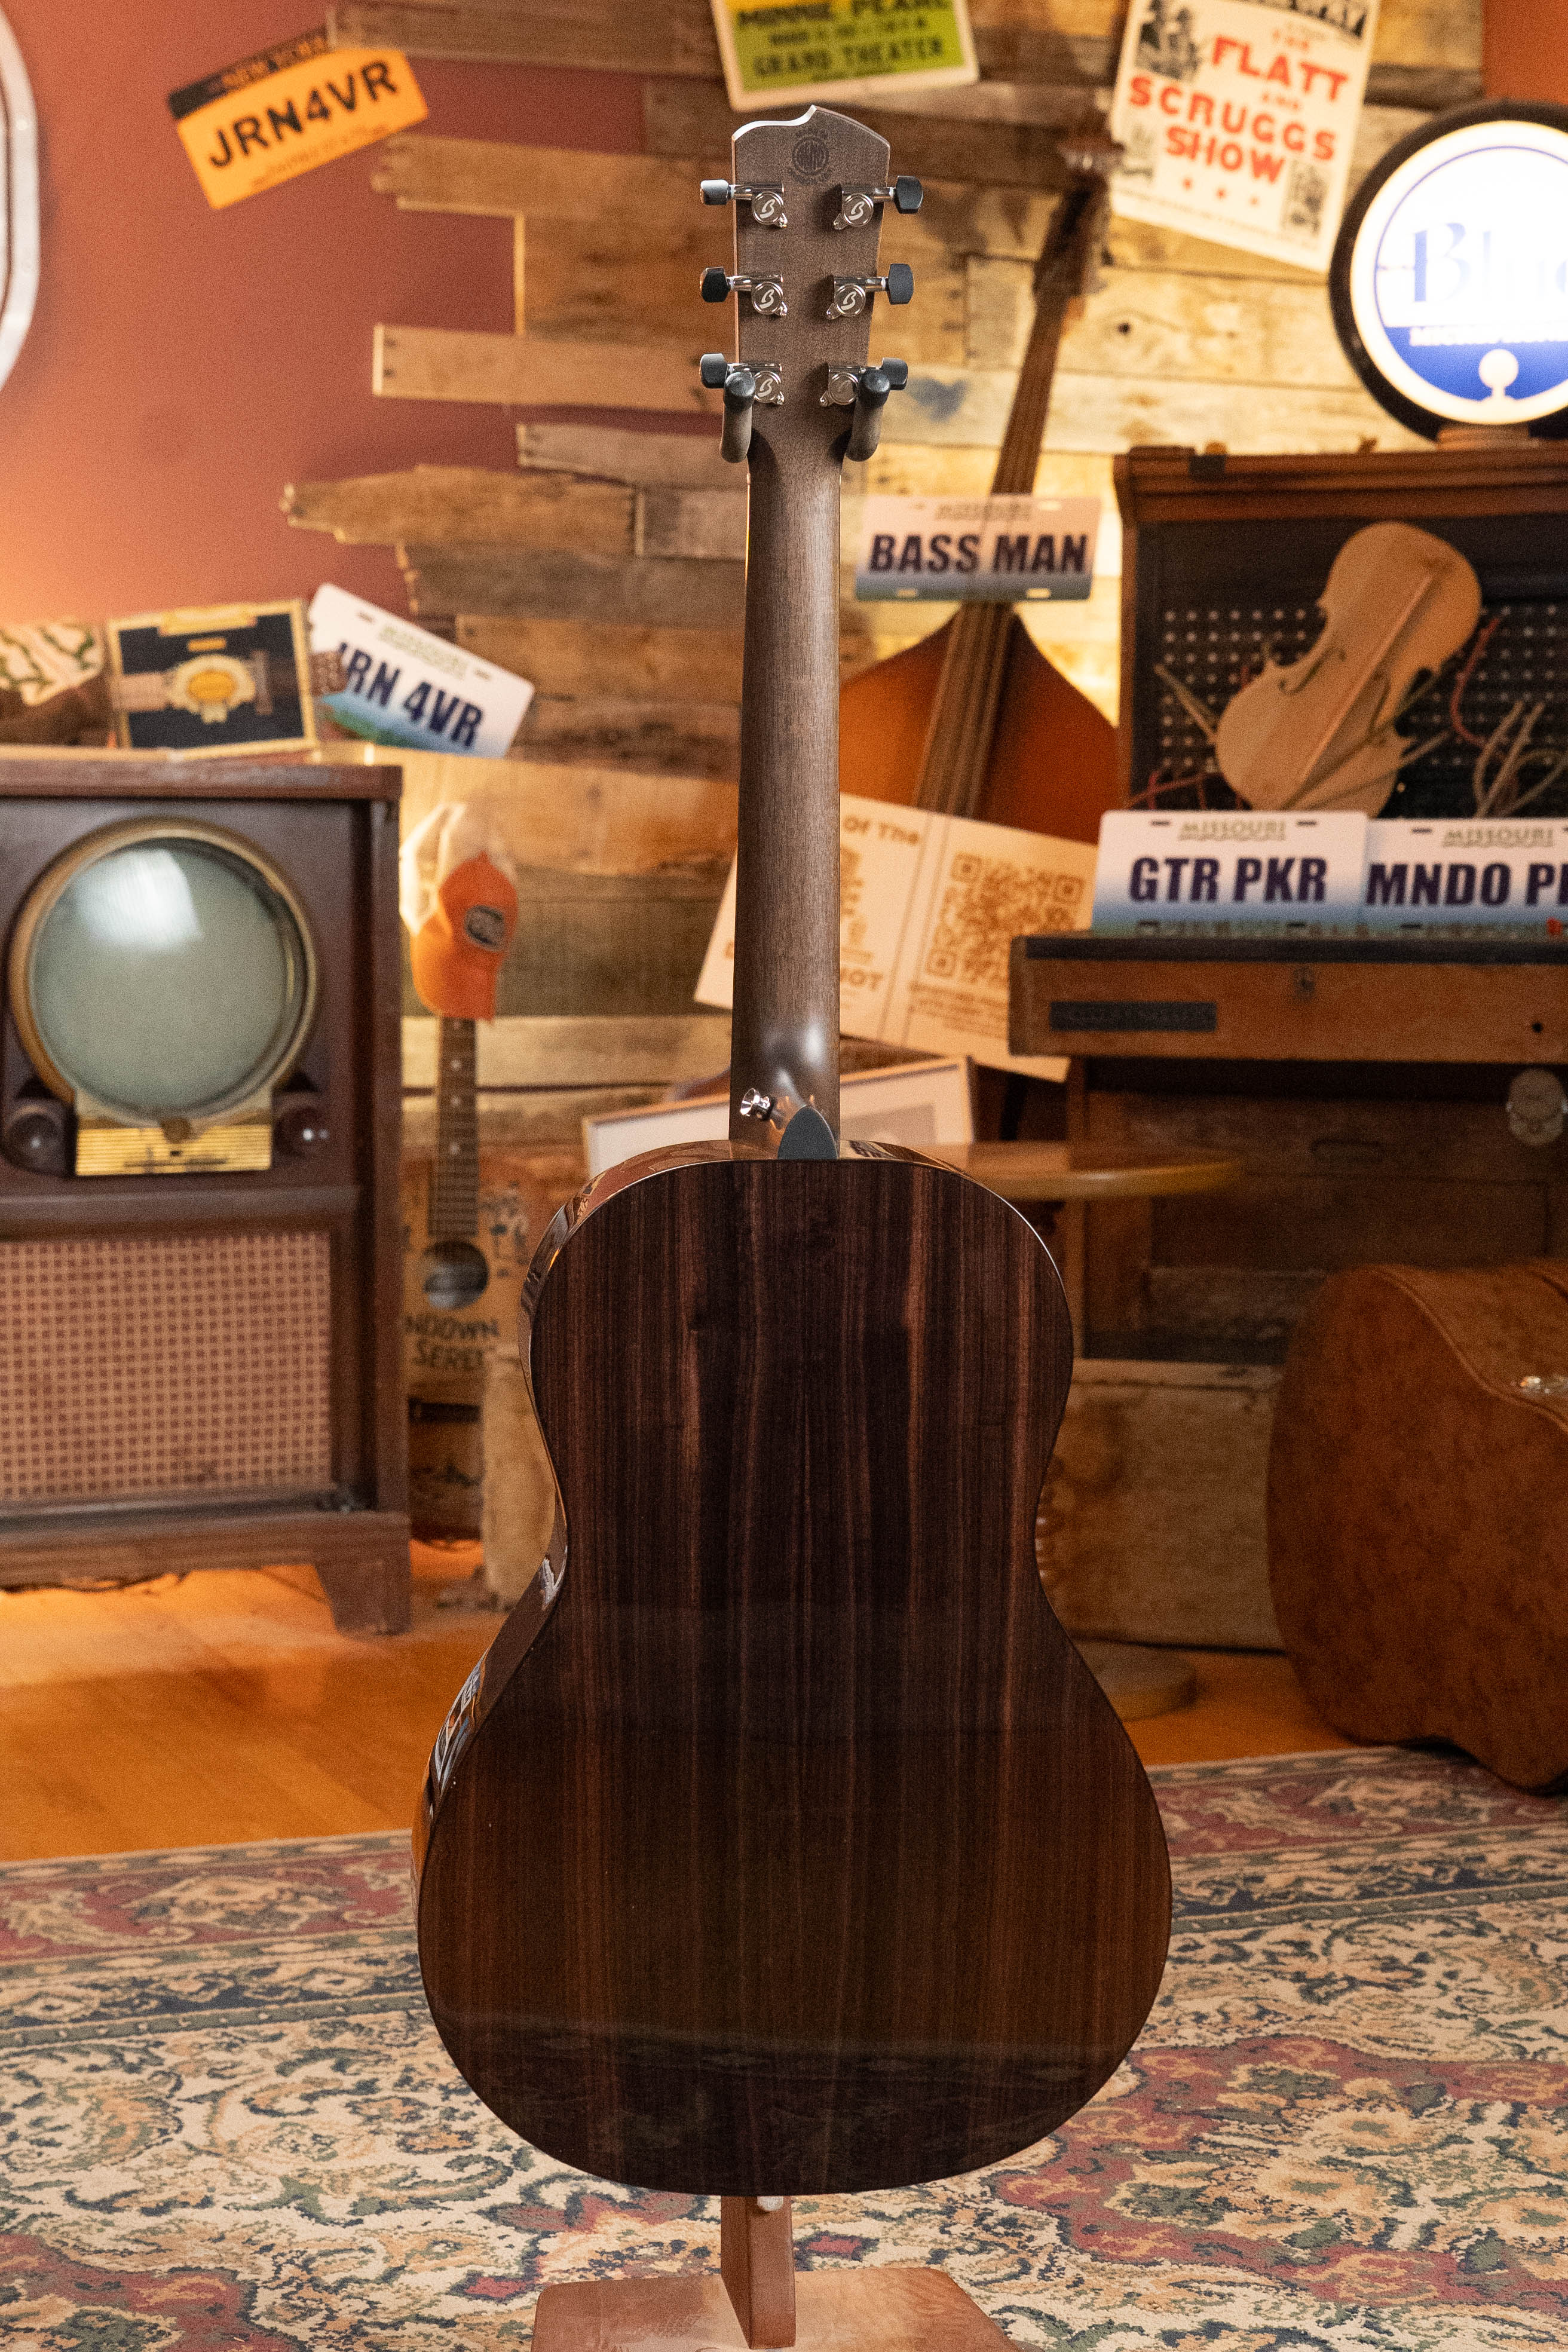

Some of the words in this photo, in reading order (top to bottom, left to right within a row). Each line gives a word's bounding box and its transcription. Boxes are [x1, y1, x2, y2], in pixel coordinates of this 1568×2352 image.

[1211, 35, 1349, 102] FLATT
[209, 60, 398, 168] JRN4VR
[1129, 75, 1336, 161] SCRUGGS
[1166, 125, 1285, 183] SHOW
[869, 534, 981, 573] BASS
[992, 534, 1089, 573] MAN
[338, 642, 401, 707] RN
[403, 681, 484, 748] 4VR
[1178, 819, 1286, 841] MISSOURI
[1441, 826, 1554, 848] MISSOURI
[1129, 856, 1220, 902] GTR
[1233, 856, 1328, 902] PKR
[1366, 863, 1511, 905] MNDO
